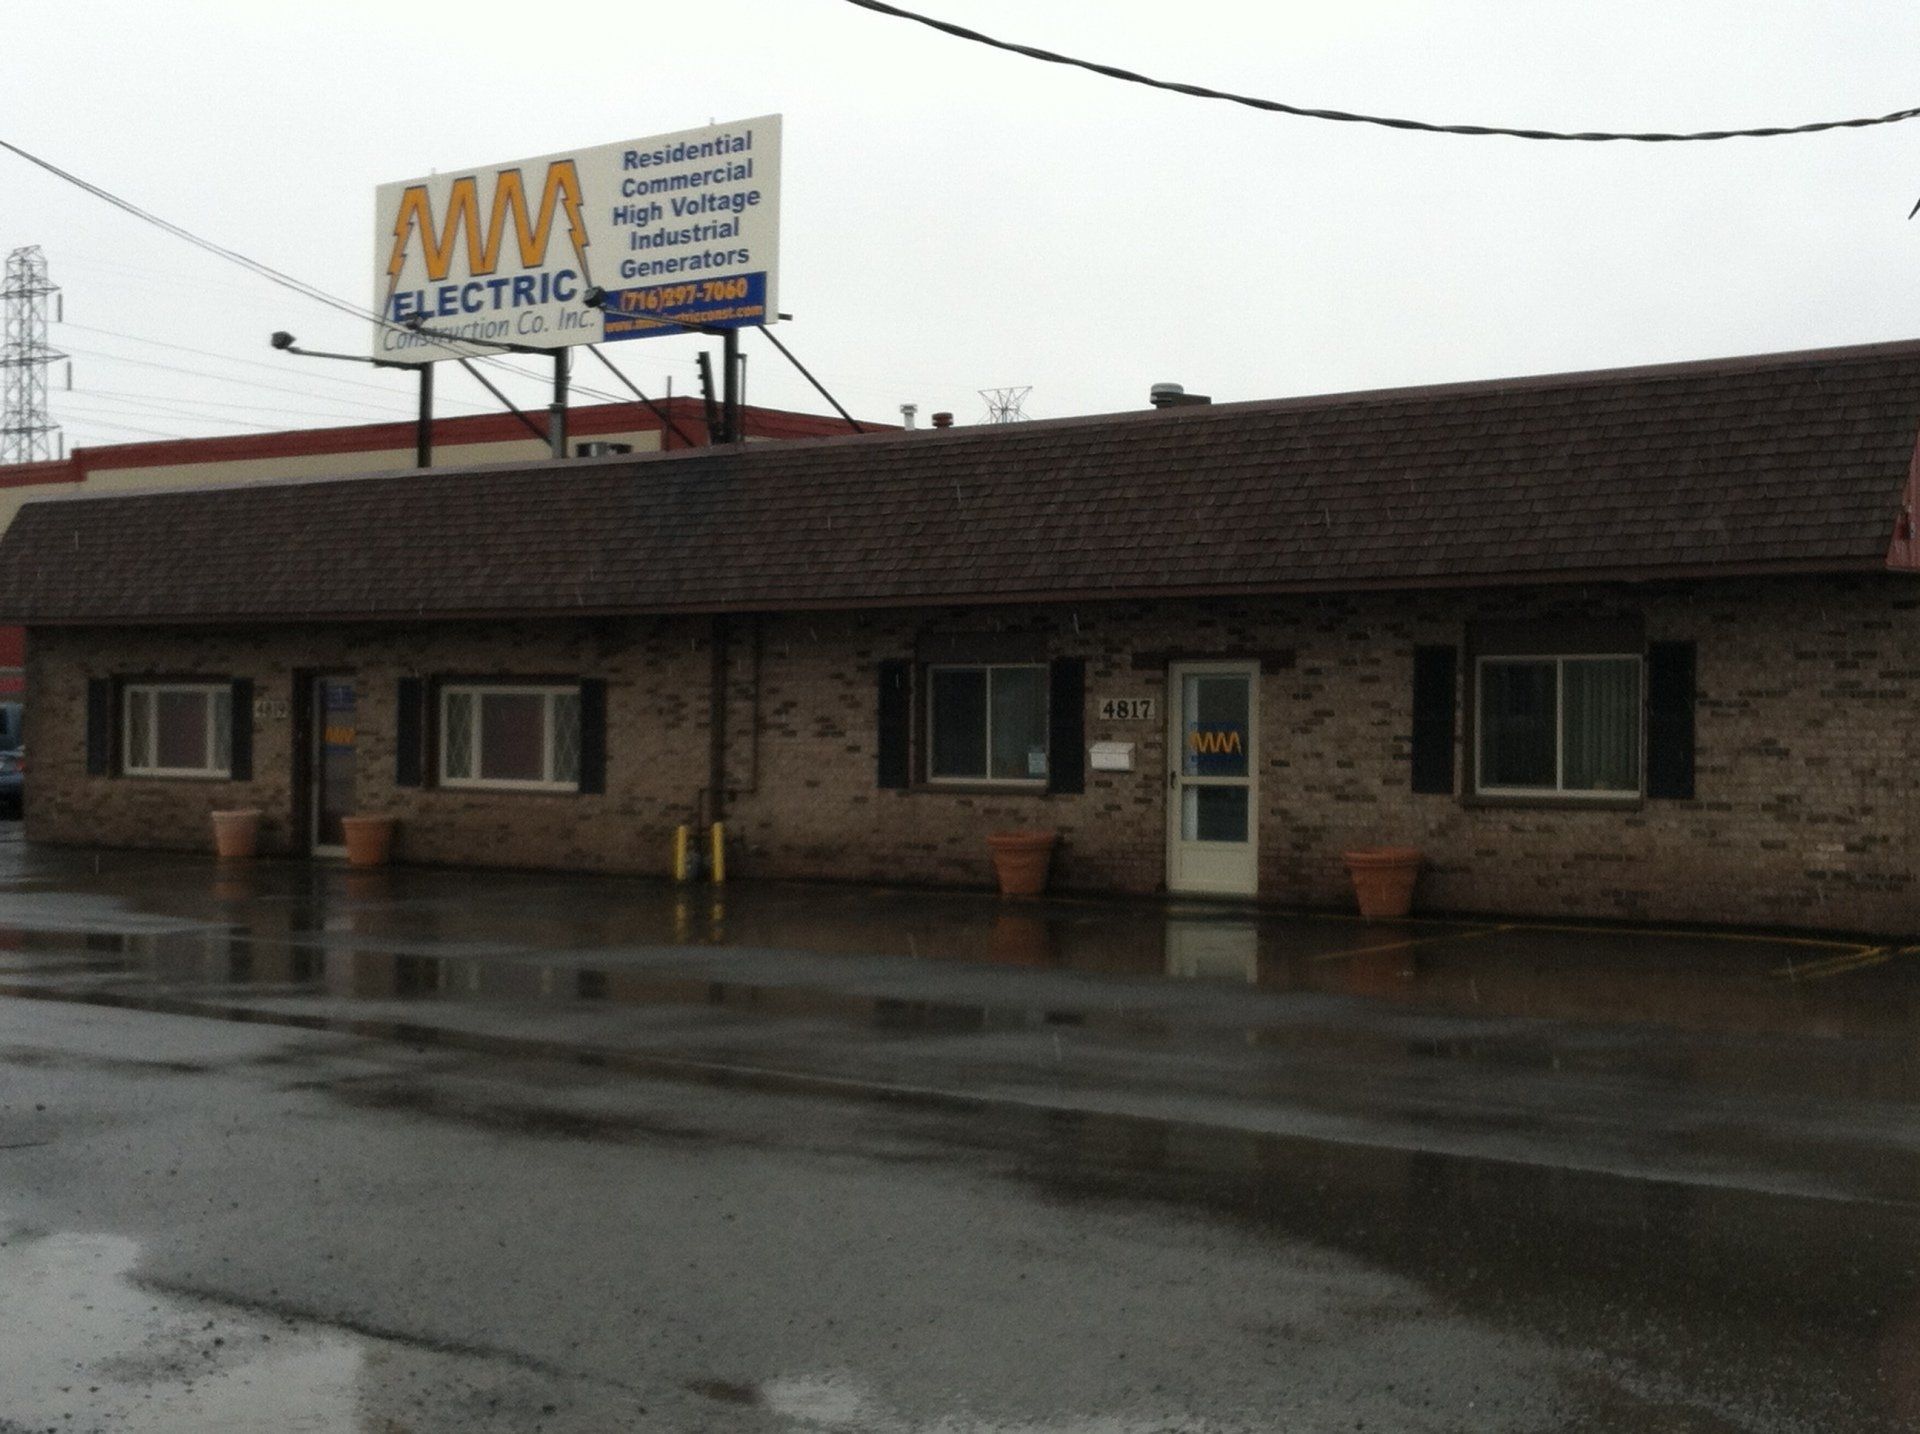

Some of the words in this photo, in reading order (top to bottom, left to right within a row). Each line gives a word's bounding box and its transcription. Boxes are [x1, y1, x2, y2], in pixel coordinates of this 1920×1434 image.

[622, 130, 753, 171] Residential
[621, 157, 754, 198] Commercial
[612, 201, 663, 227] High
[670, 189, 761, 224] Voltage
[630, 216, 740, 251] Industrial
[620, 248, 750, 279] Generators
[391, 269, 578, 323] ELECTRIC
[517, 310, 549, 335] Co.
[558, 306, 596, 330] Inc.
[1102, 700, 1151, 719] 4817
